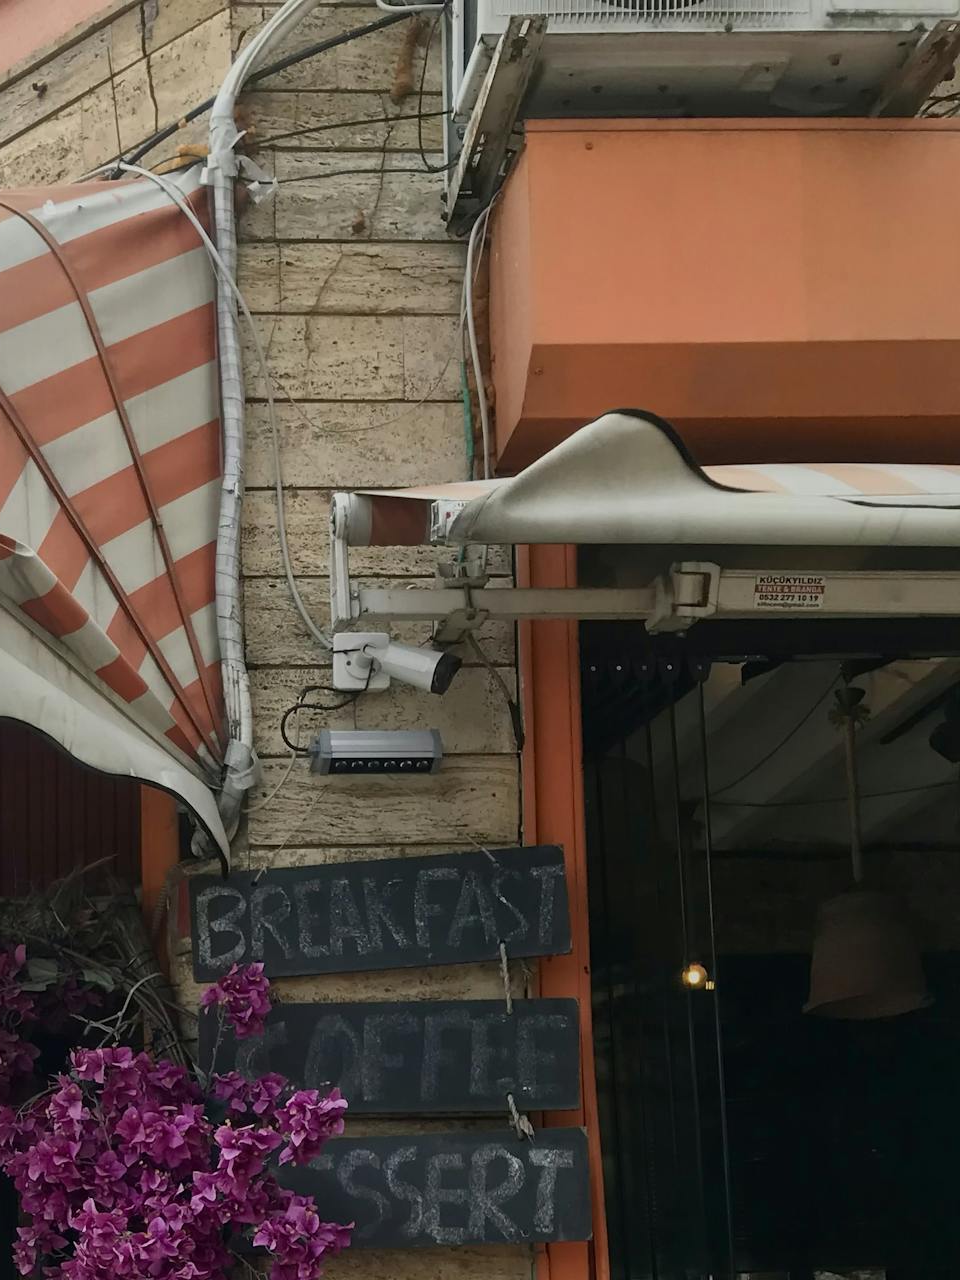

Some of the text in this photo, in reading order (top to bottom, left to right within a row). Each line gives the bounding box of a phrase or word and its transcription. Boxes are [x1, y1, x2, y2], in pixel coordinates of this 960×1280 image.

[759, 576, 823, 584] KÜÇÜKYILDIZ
[798, 594, 807, 602] 10
[195, 863, 565, 970] BREAKFAST
